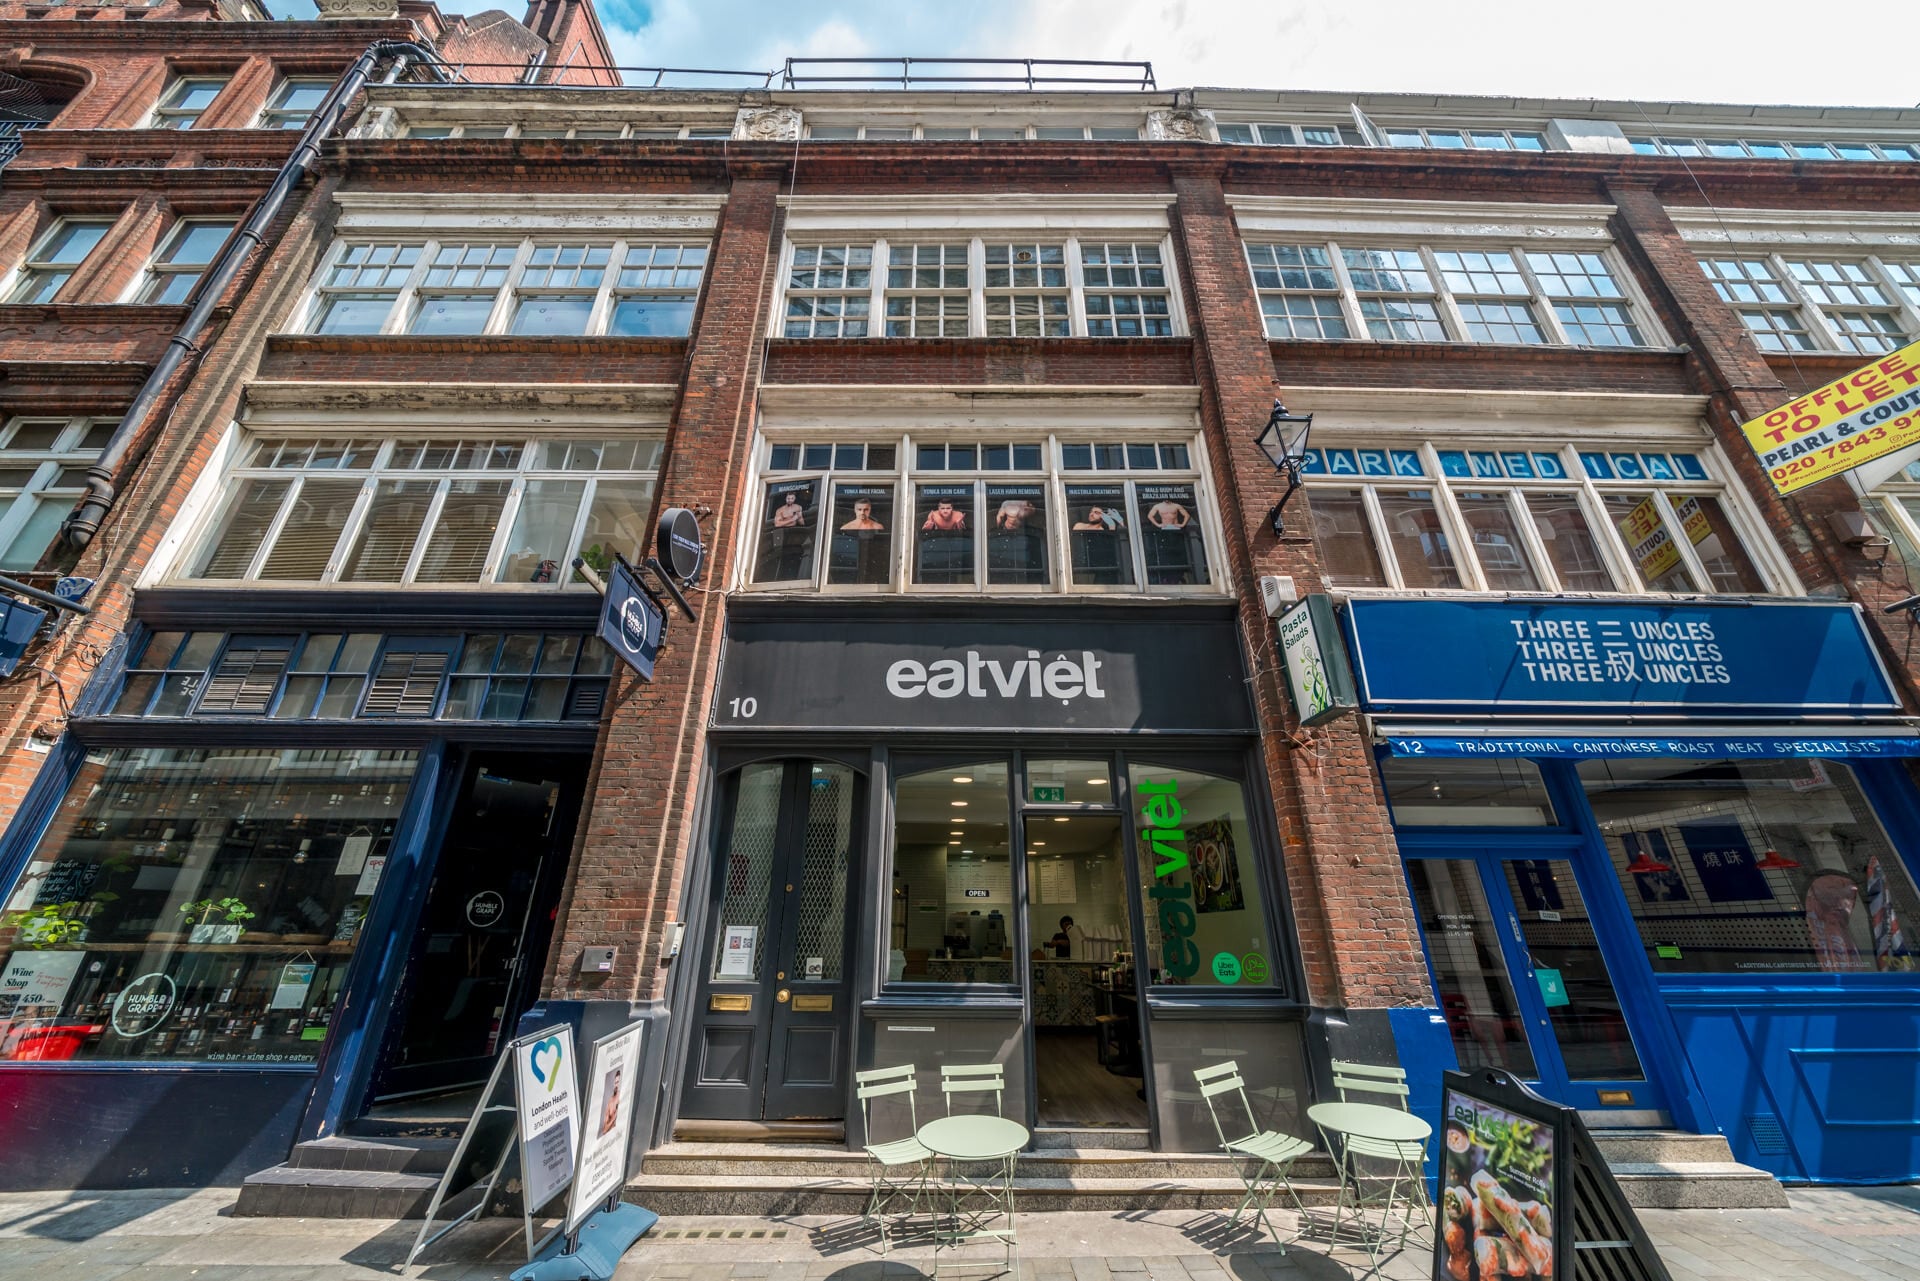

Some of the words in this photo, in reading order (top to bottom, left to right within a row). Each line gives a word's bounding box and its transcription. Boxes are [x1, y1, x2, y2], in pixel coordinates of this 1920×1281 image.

[1764, 355, 1908, 428] OFFICE
[1763, 414, 1821, 444] TO
[1834, 364, 1920, 416] LET
[1764, 431, 1833, 468] PEARL
[1836, 422, 1856, 437] &
[1772, 456, 1816, 480] 020
[1821, 427, 1888, 460] 7843
[1300, 451, 1420, 475] PARK
[1476, 451, 1703, 479] MEDICAL
[1281, 610, 1308, 638] Pasta
[1510, 620, 1592, 639] THREE
[1630, 621, 1715, 641] UNCLES
[1285, 626, 1309, 650] Salads
[1516, 641, 1599, 660] THREE
[1637, 642, 1723, 662] UNCLES
[1597, 620, 1644, 683] 三叔
[1522, 662, 1605, 682] THREE
[1644, 664, 1731, 684] UNCLES
[729, 697, 758, 718] 10
[1398, 740, 1425, 754] 12
[1455, 742, 1566, 754] TRADITIONAL
[1573, 742, 1661, 754] CANTONESE
[1668, 742, 1715, 753] ROAST
[1725, 742, 1765, 753] MEAT
[1773, 742, 1881, 754] SPECIALISTS
[11, 967, 34, 977] Wine
[4, 978, 29, 990] Shop
[127, 1003, 161, 1014] GRAPE
[128, 994, 166, 1004] HUMBLE
[207, 1053, 225, 1061] wine
[226, 1052, 241, 1061] bar
[247, 1053, 265, 1061] wine
[265, 1053, 283, 1062] shop
[289, 1053, 315, 1063] eatery
[531, 1100, 552, 1117] London
[552, 1090, 568, 1104] Health
[533, 1116, 544, 1131] and
[544, 1104, 568, 1124] well-being
[1509, 1165, 1532, 1182] Summer
